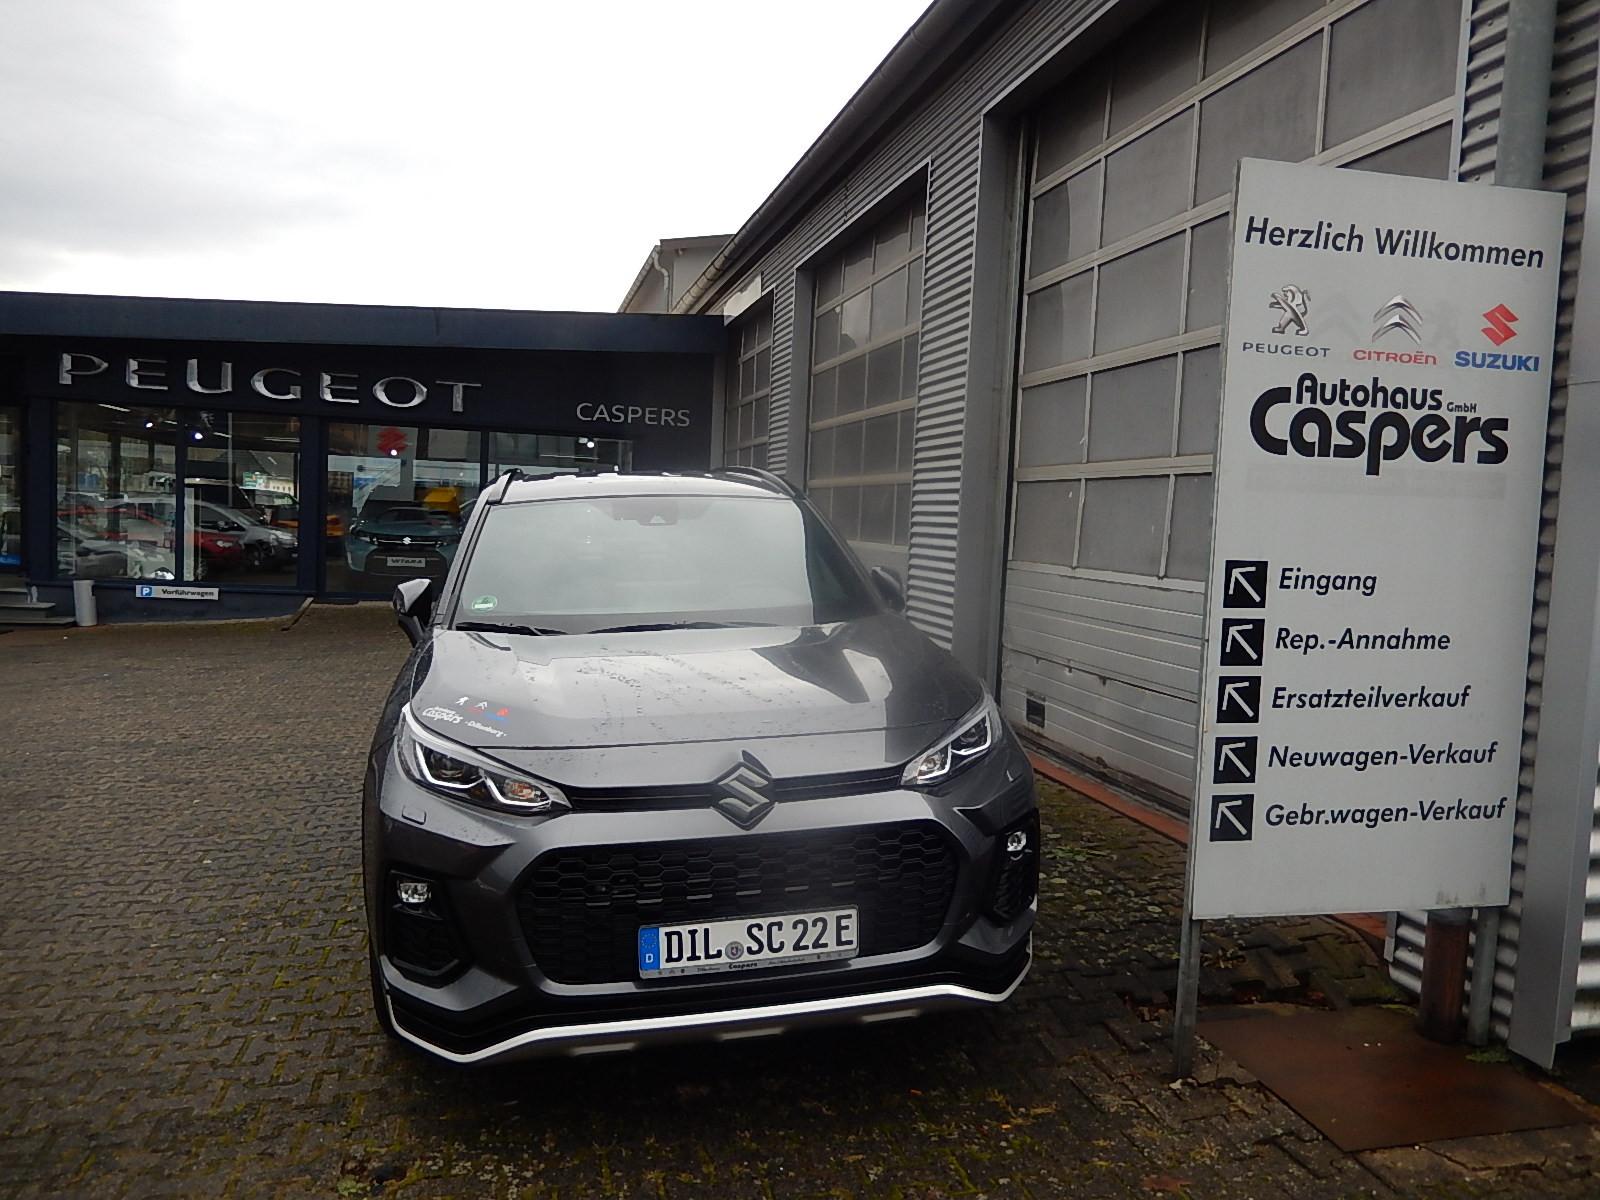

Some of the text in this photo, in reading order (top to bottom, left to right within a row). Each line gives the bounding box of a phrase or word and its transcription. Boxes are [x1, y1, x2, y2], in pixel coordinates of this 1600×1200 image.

[1245, 216, 1545, 268] Herzlich Willkommen
[1242, 342, 1331, 358] PEUGEOT
[1454, 350, 1540, 372] SUZUKI
[58, 352, 483, 413] PEUGEOT
[1296, 372, 1443, 411] Autohaus
[576, 401, 692, 428] CASPERS
[1250, 387, 1509, 475] Caspers
[161, 588, 215, 598] Vorführwagen
[1278, 566, 1378, 596] Eingang
[1275, 627, 1451, 655] Rep.-Annahme
[1271, 685, 1472, 710] Ersatzteilverkauf
[1267, 741, 1498, 771] Neuwagen-Verkauf
[1264, 797, 1508, 829] Gebr.wagen-Verkauf
[665, 928, 722, 964] DIL
